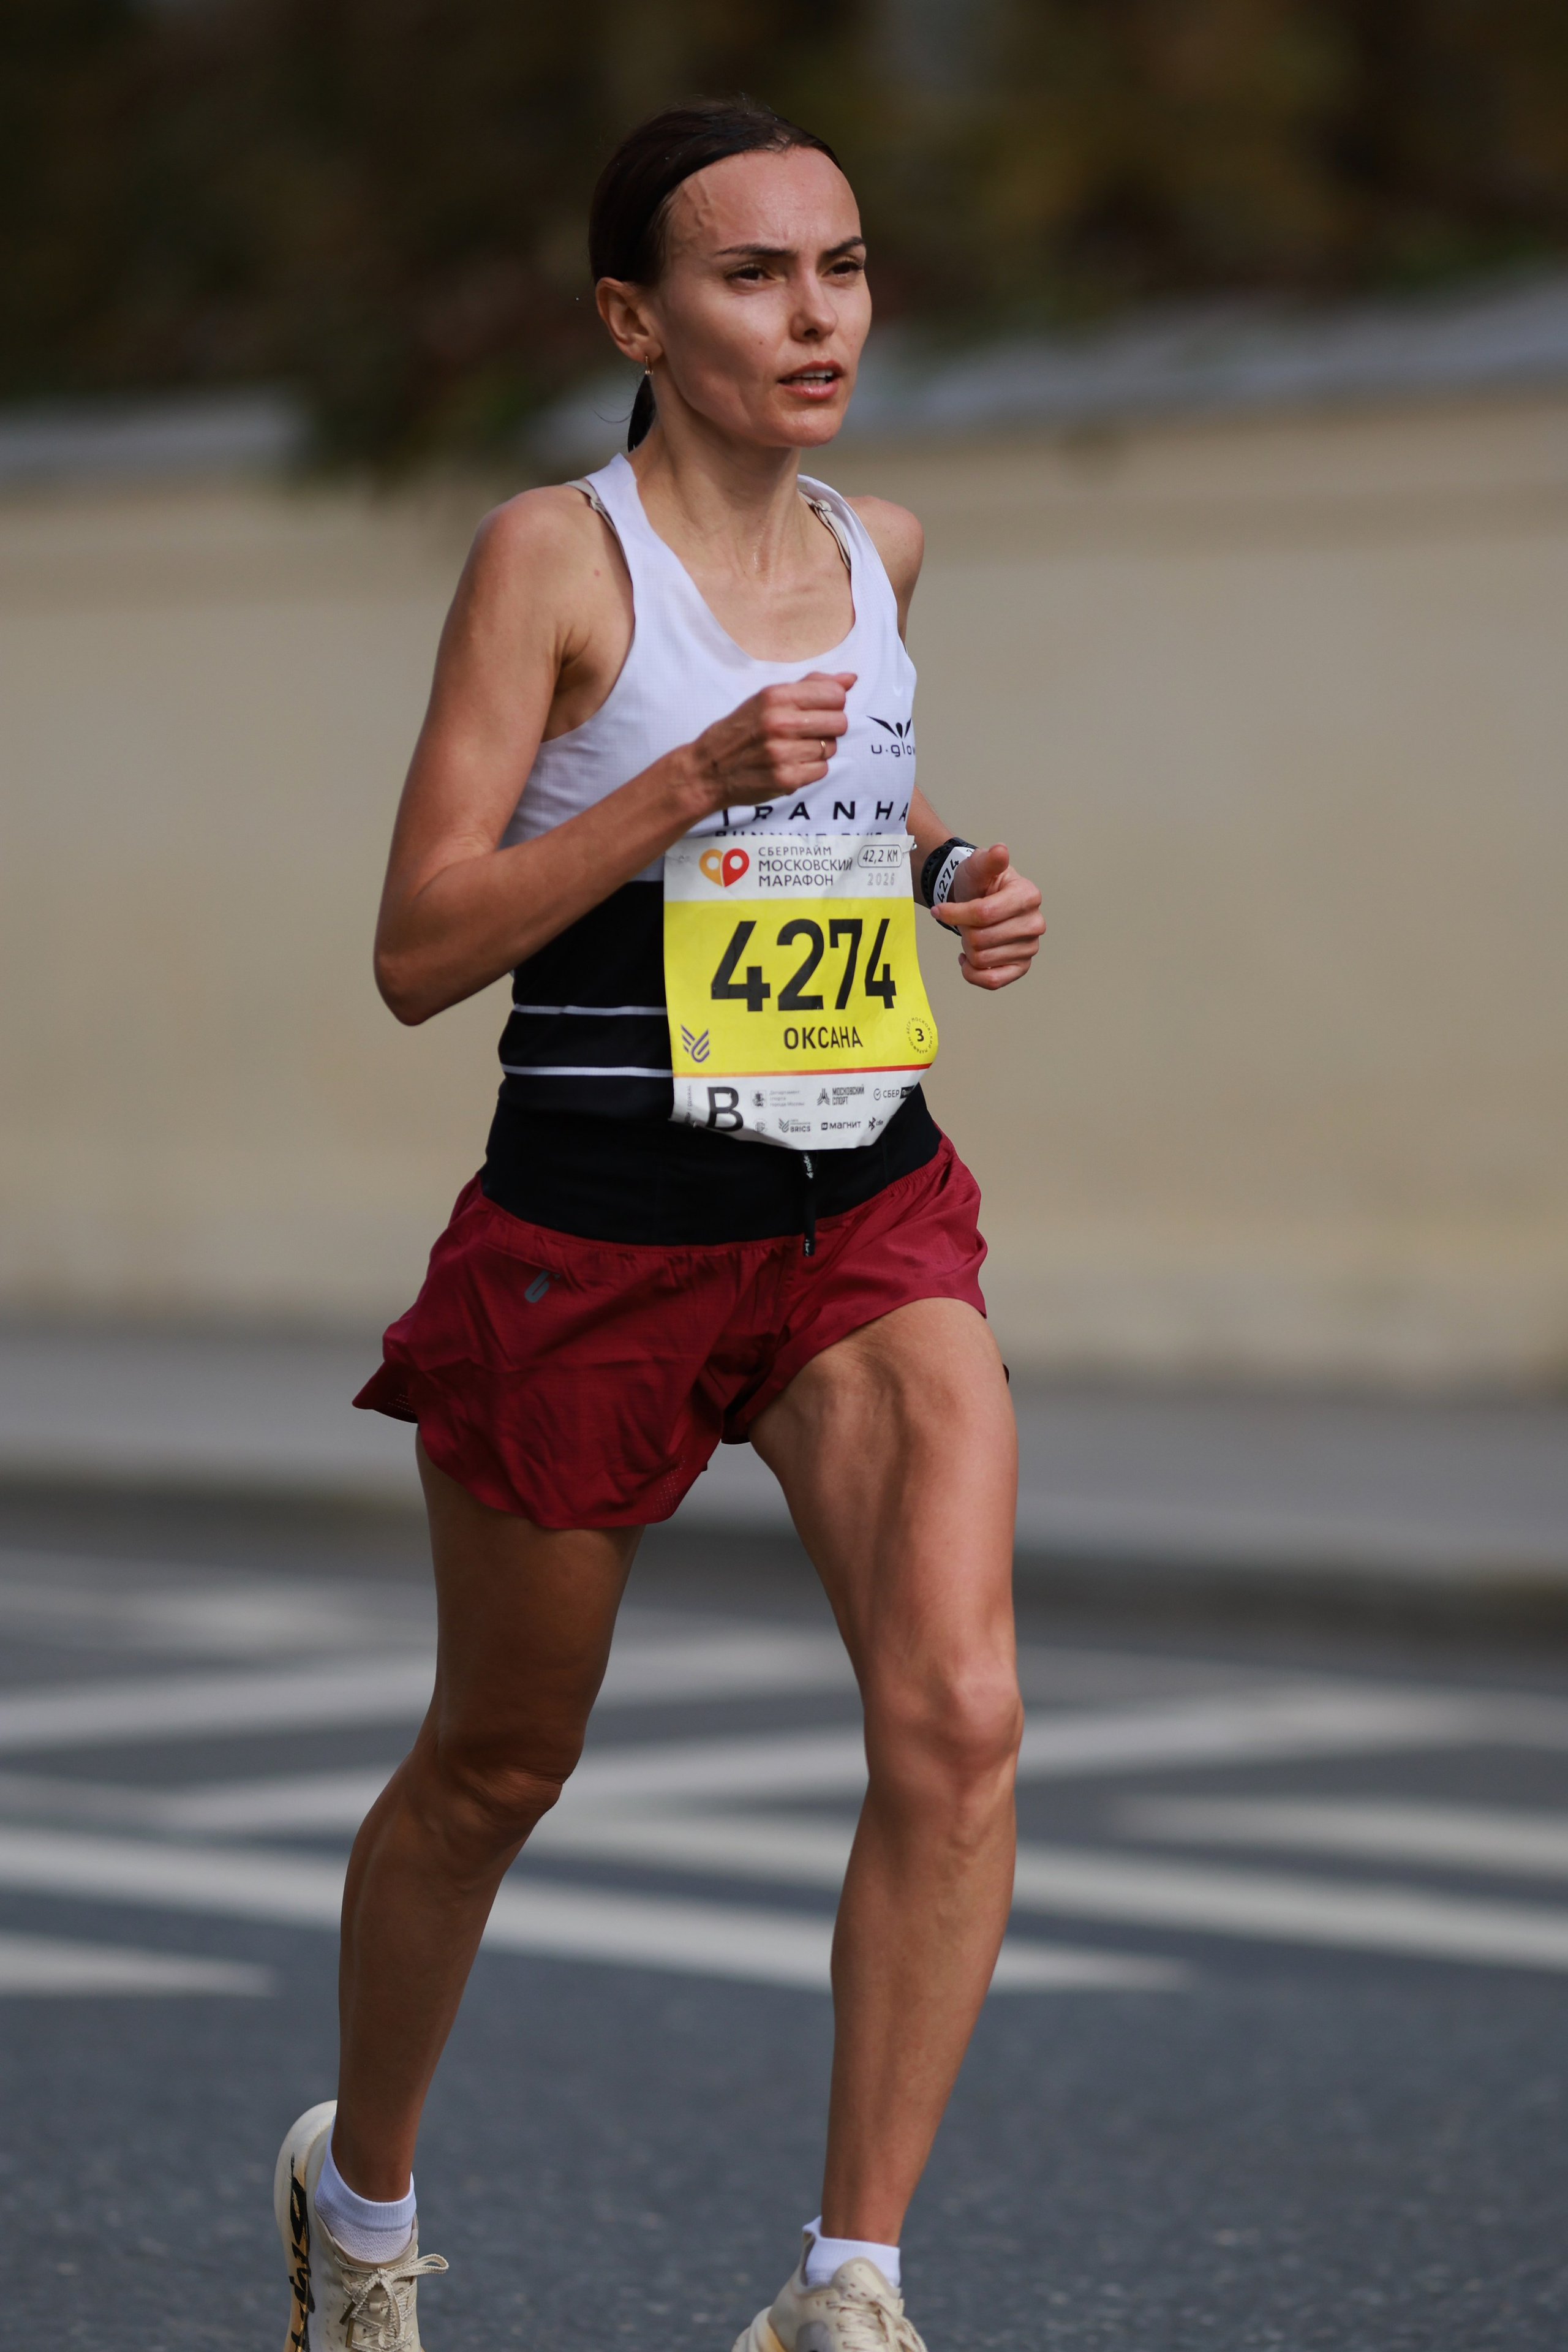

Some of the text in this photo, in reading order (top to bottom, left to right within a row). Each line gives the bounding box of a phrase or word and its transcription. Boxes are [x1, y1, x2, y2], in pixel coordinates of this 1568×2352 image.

[722, 801, 908, 826] IRANHA
[758, 845, 832, 856] СБЕРПРАЙМ
[862, 850, 884, 864] 42,2
[759, 858, 853, 872] МОСКОВСКИЙ
[759, 874, 833, 887] МАРАФОН
[937, 859, 960, 903] 4274
[710, 919, 897, 1012] 4274
[783, 1026, 863, 1050] ОКСАНА
[915, 1028, 924, 1042] 3
[832, 1084, 864, 1096] МОСКОВСКИЙ
[883, 1090, 900, 1098] СБЕР
[832, 1096, 848, 1106] СПОРТ
